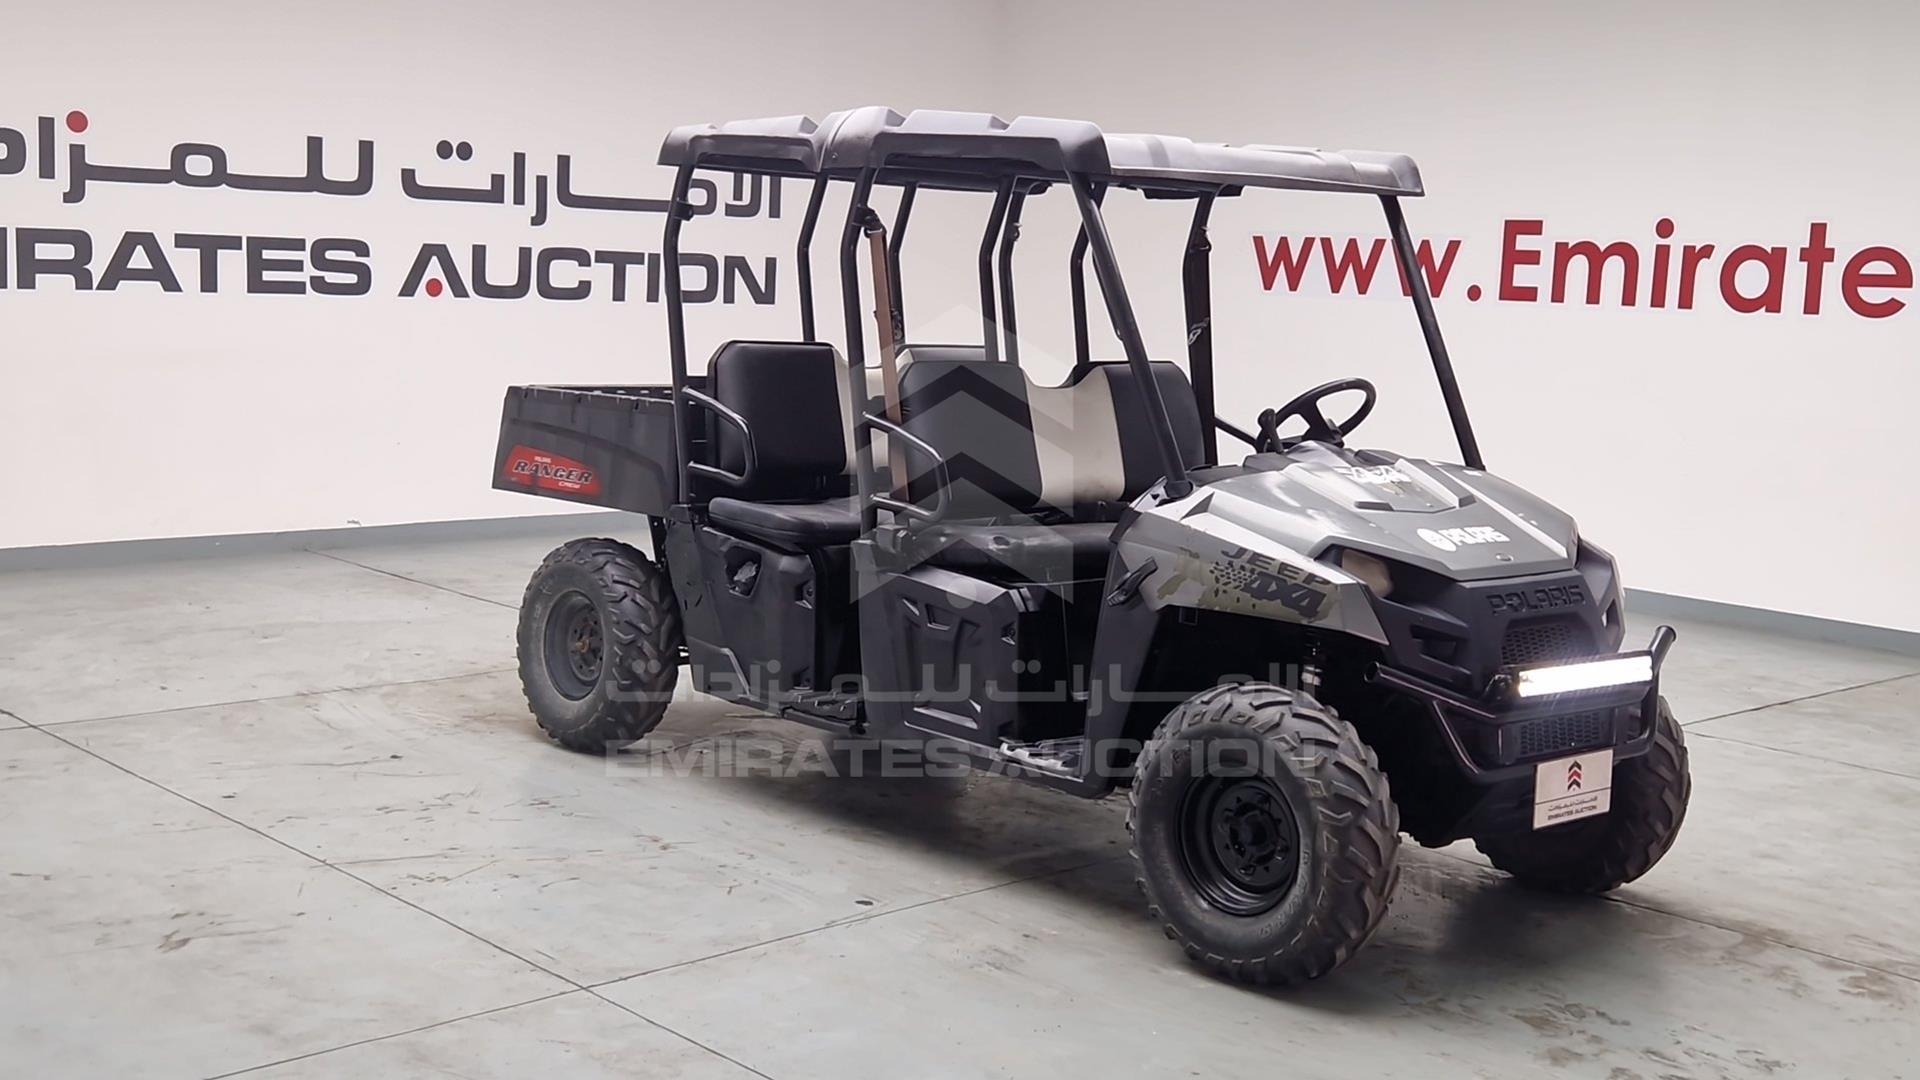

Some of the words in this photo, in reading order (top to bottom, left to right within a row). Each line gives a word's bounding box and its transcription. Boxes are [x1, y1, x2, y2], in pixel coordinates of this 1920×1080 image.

[398, 243, 777, 306] AUCTION
[512, 459, 593, 484] RANGER
[1220, 546, 1334, 587] JEEP
[1485, 585, 1588, 615] POLARIS
